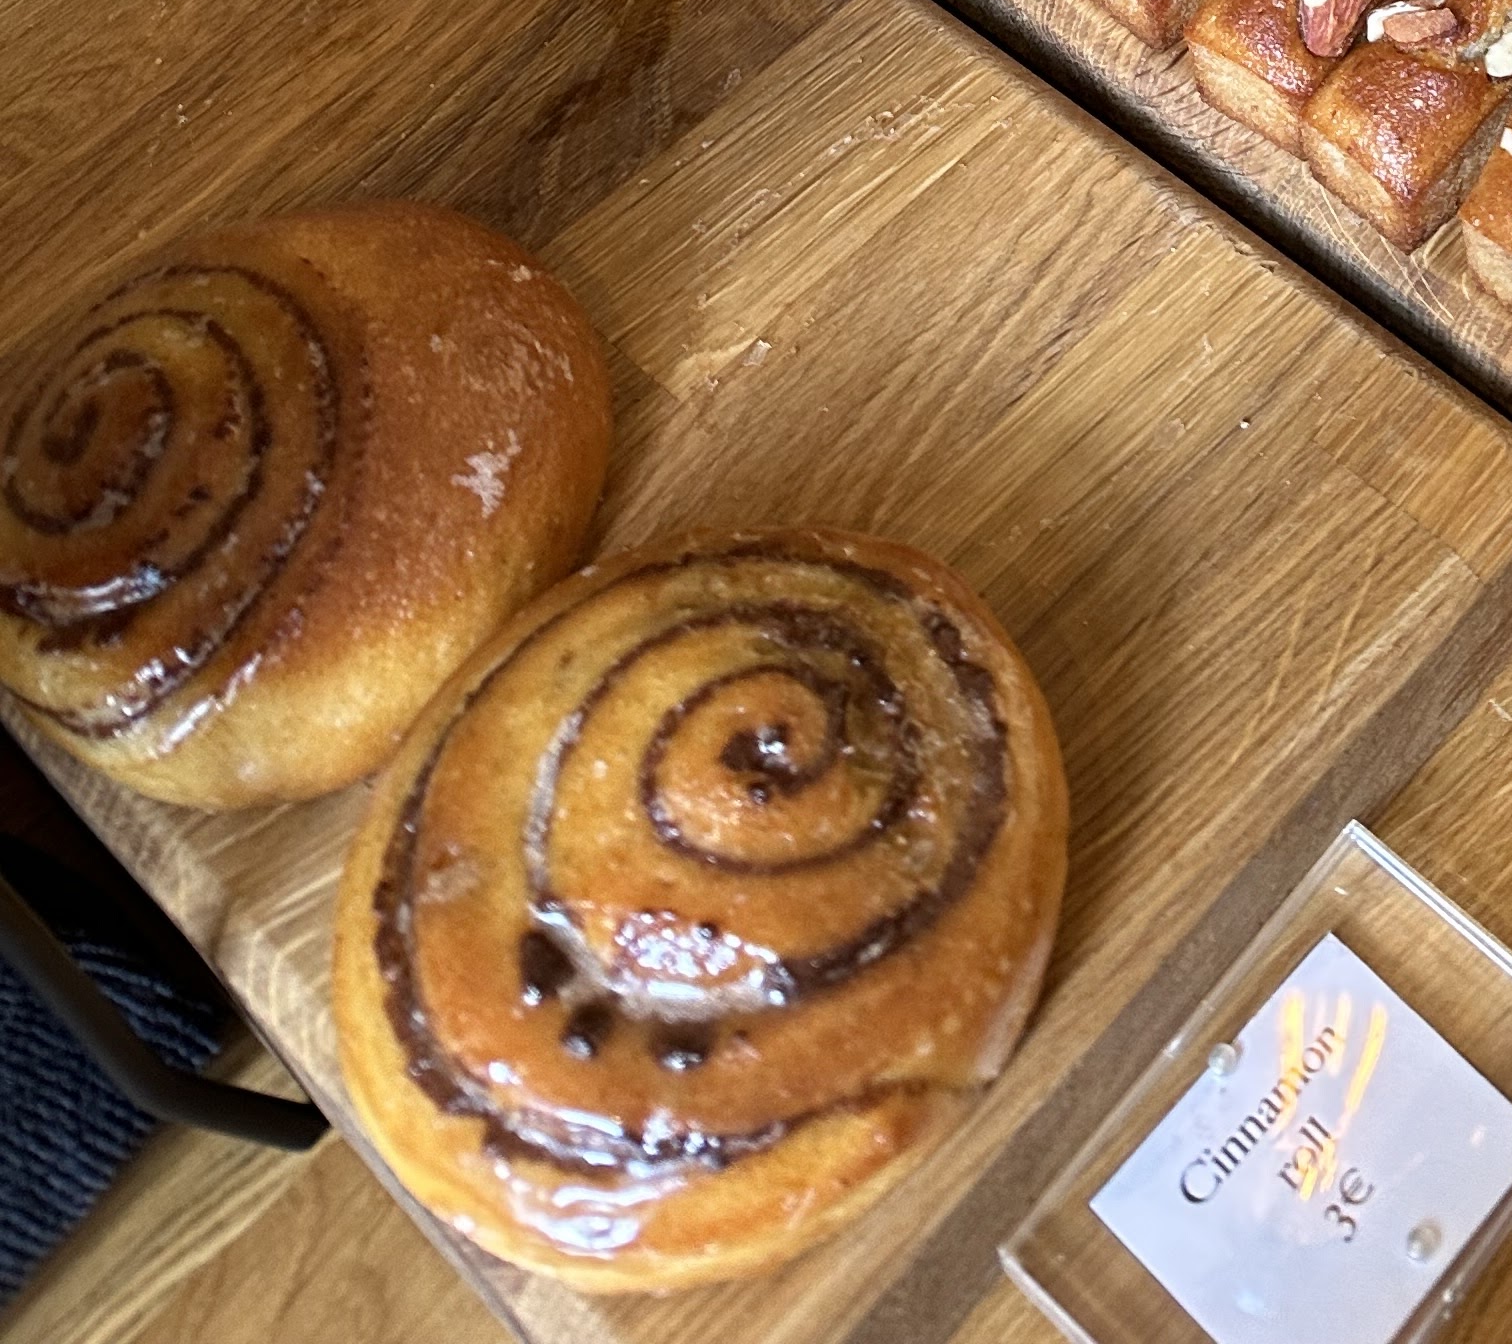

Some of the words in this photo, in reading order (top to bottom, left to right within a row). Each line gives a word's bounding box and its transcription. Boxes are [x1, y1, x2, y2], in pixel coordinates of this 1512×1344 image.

[1179, 1024, 1343, 1207] Cinnamon
[1276, 1114, 1336, 1193] roll
[1322, 1165, 1378, 1245] 3€
